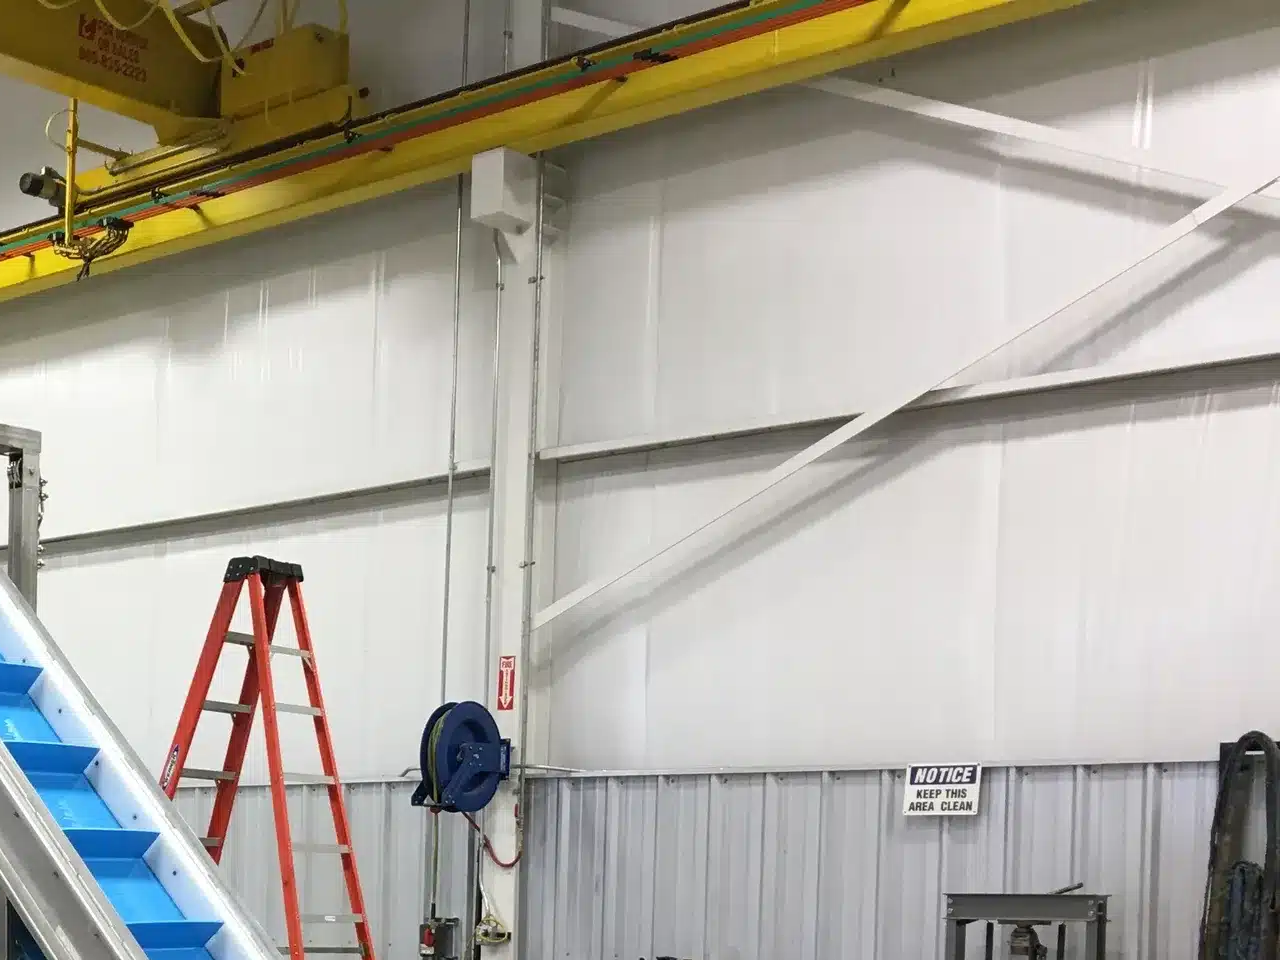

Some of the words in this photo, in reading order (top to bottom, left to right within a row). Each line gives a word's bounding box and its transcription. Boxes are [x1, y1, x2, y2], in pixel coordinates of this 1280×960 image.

[914, 767, 974, 783] NOTICE
[916, 788, 942, 799] KEEP
[945, 788, 967, 799] THIS
[908, 801, 935, 812] AREA
[940, 801, 973, 812] CLEAN
